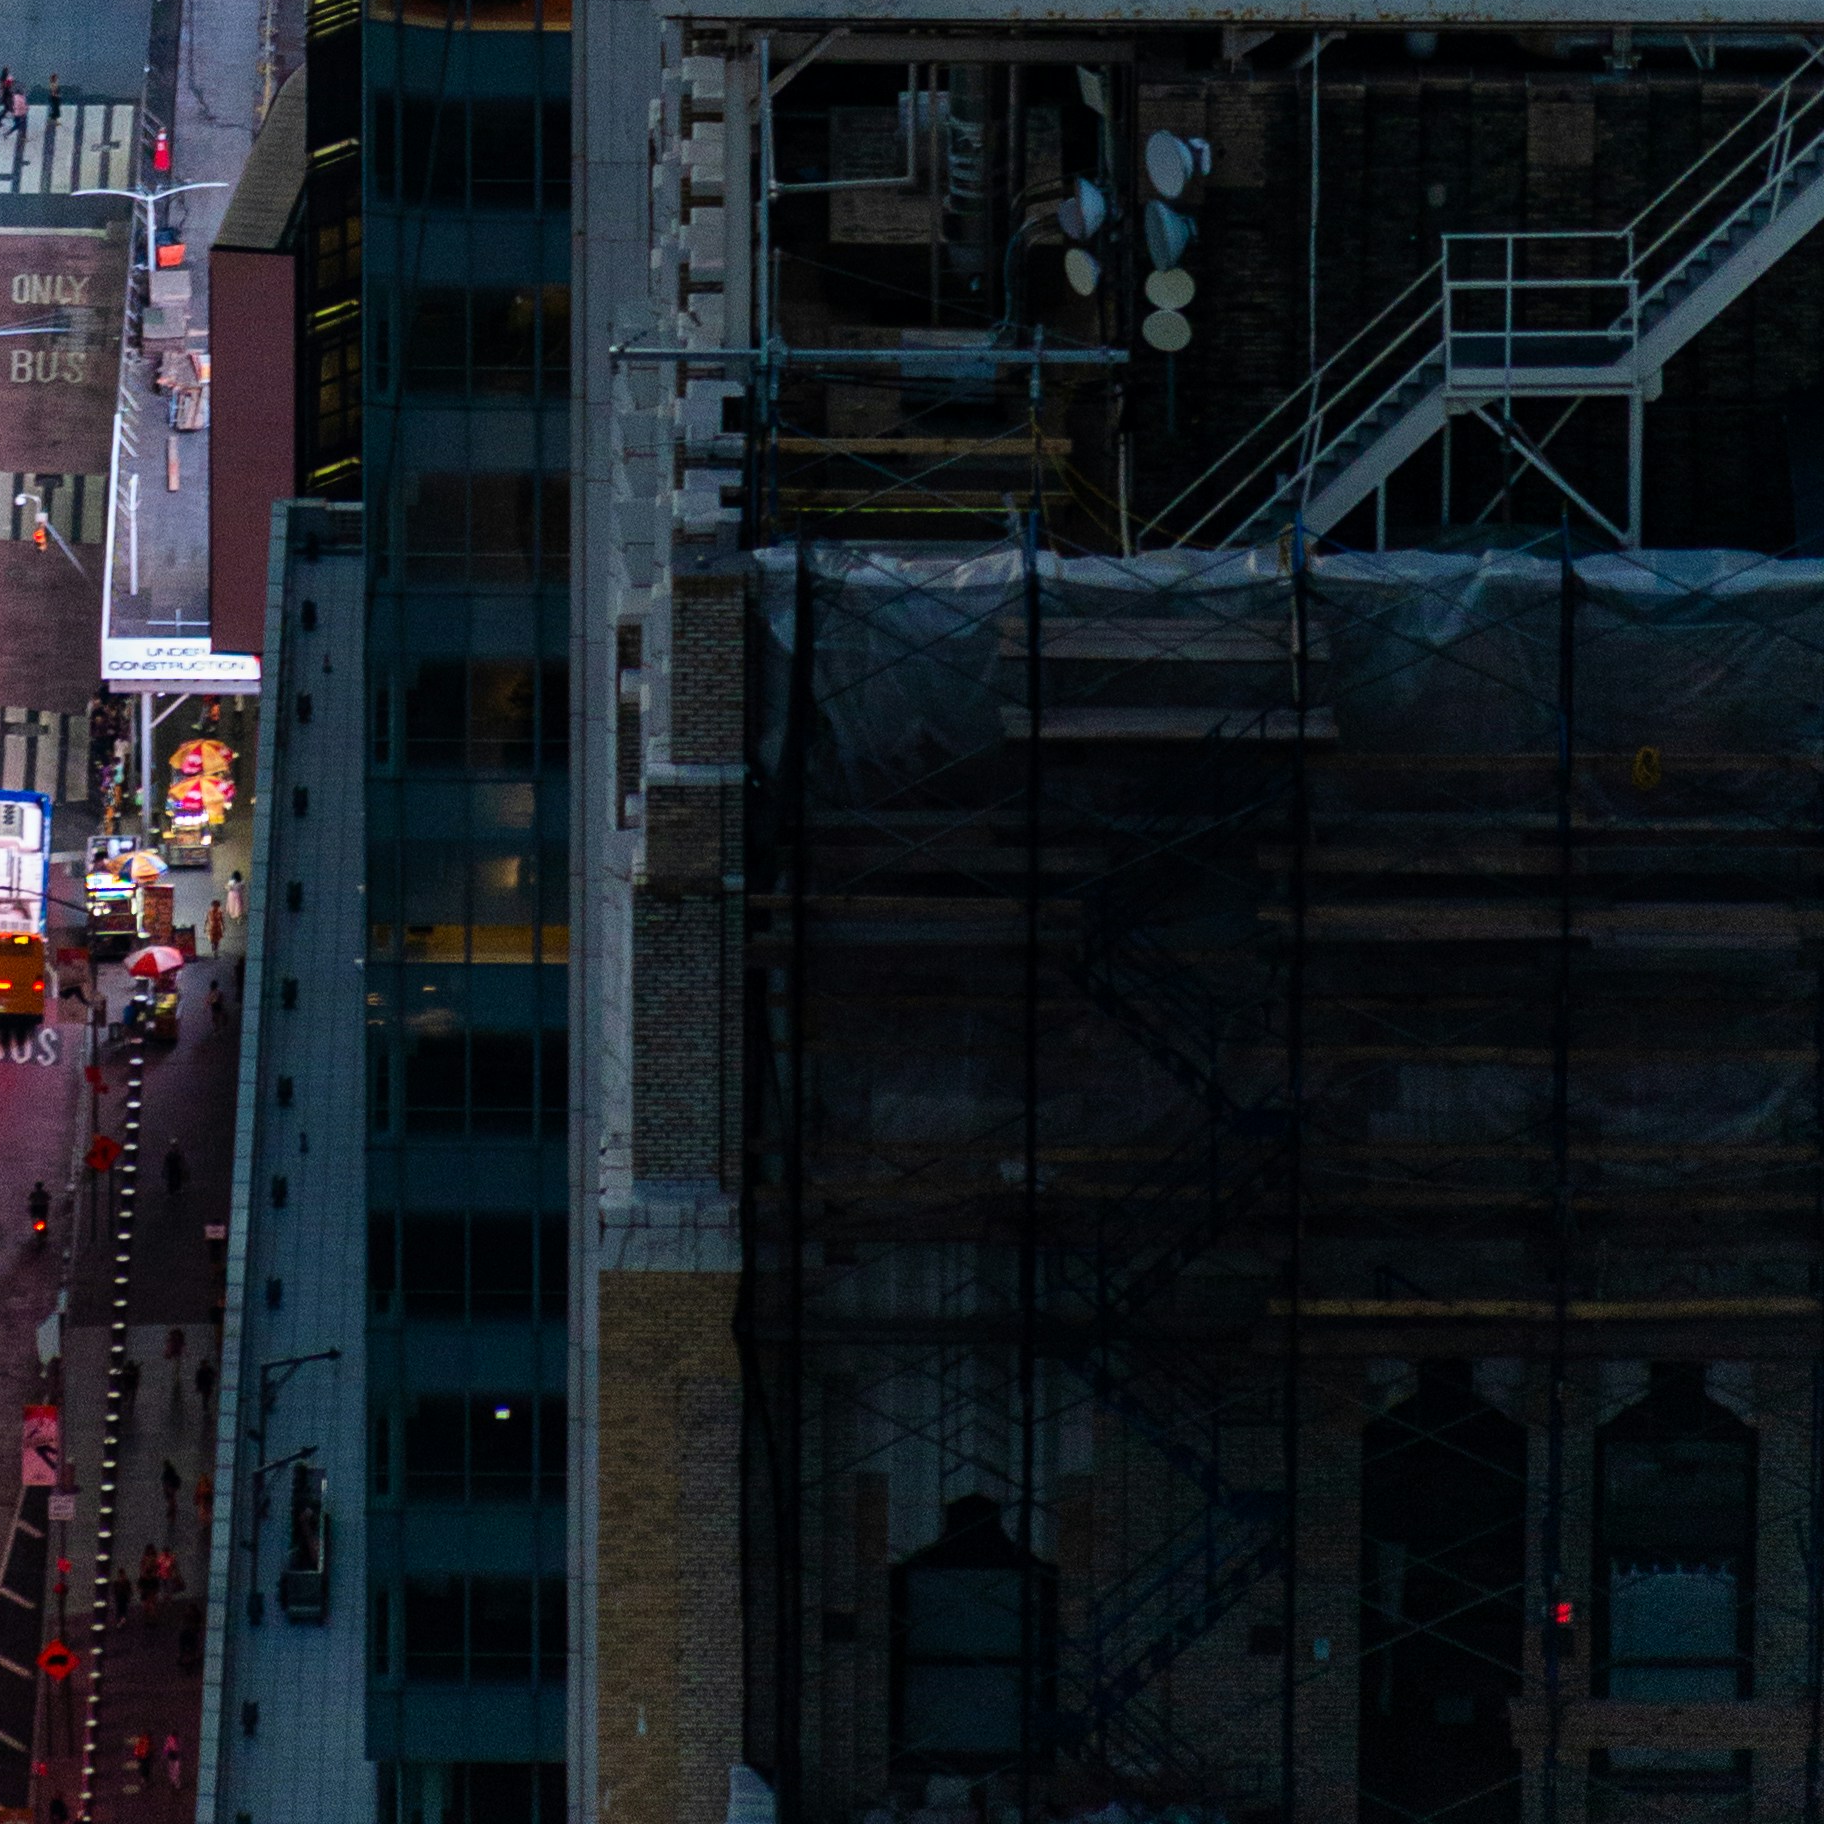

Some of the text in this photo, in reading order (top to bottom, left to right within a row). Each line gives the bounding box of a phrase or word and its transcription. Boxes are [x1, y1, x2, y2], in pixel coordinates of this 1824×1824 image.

[11, 273, 91, 305] ONLY
[10, 349, 87, 383] BUS
[146, 647, 206, 657] UNDER
[108, 660, 244, 671] CONSTRUCTION
